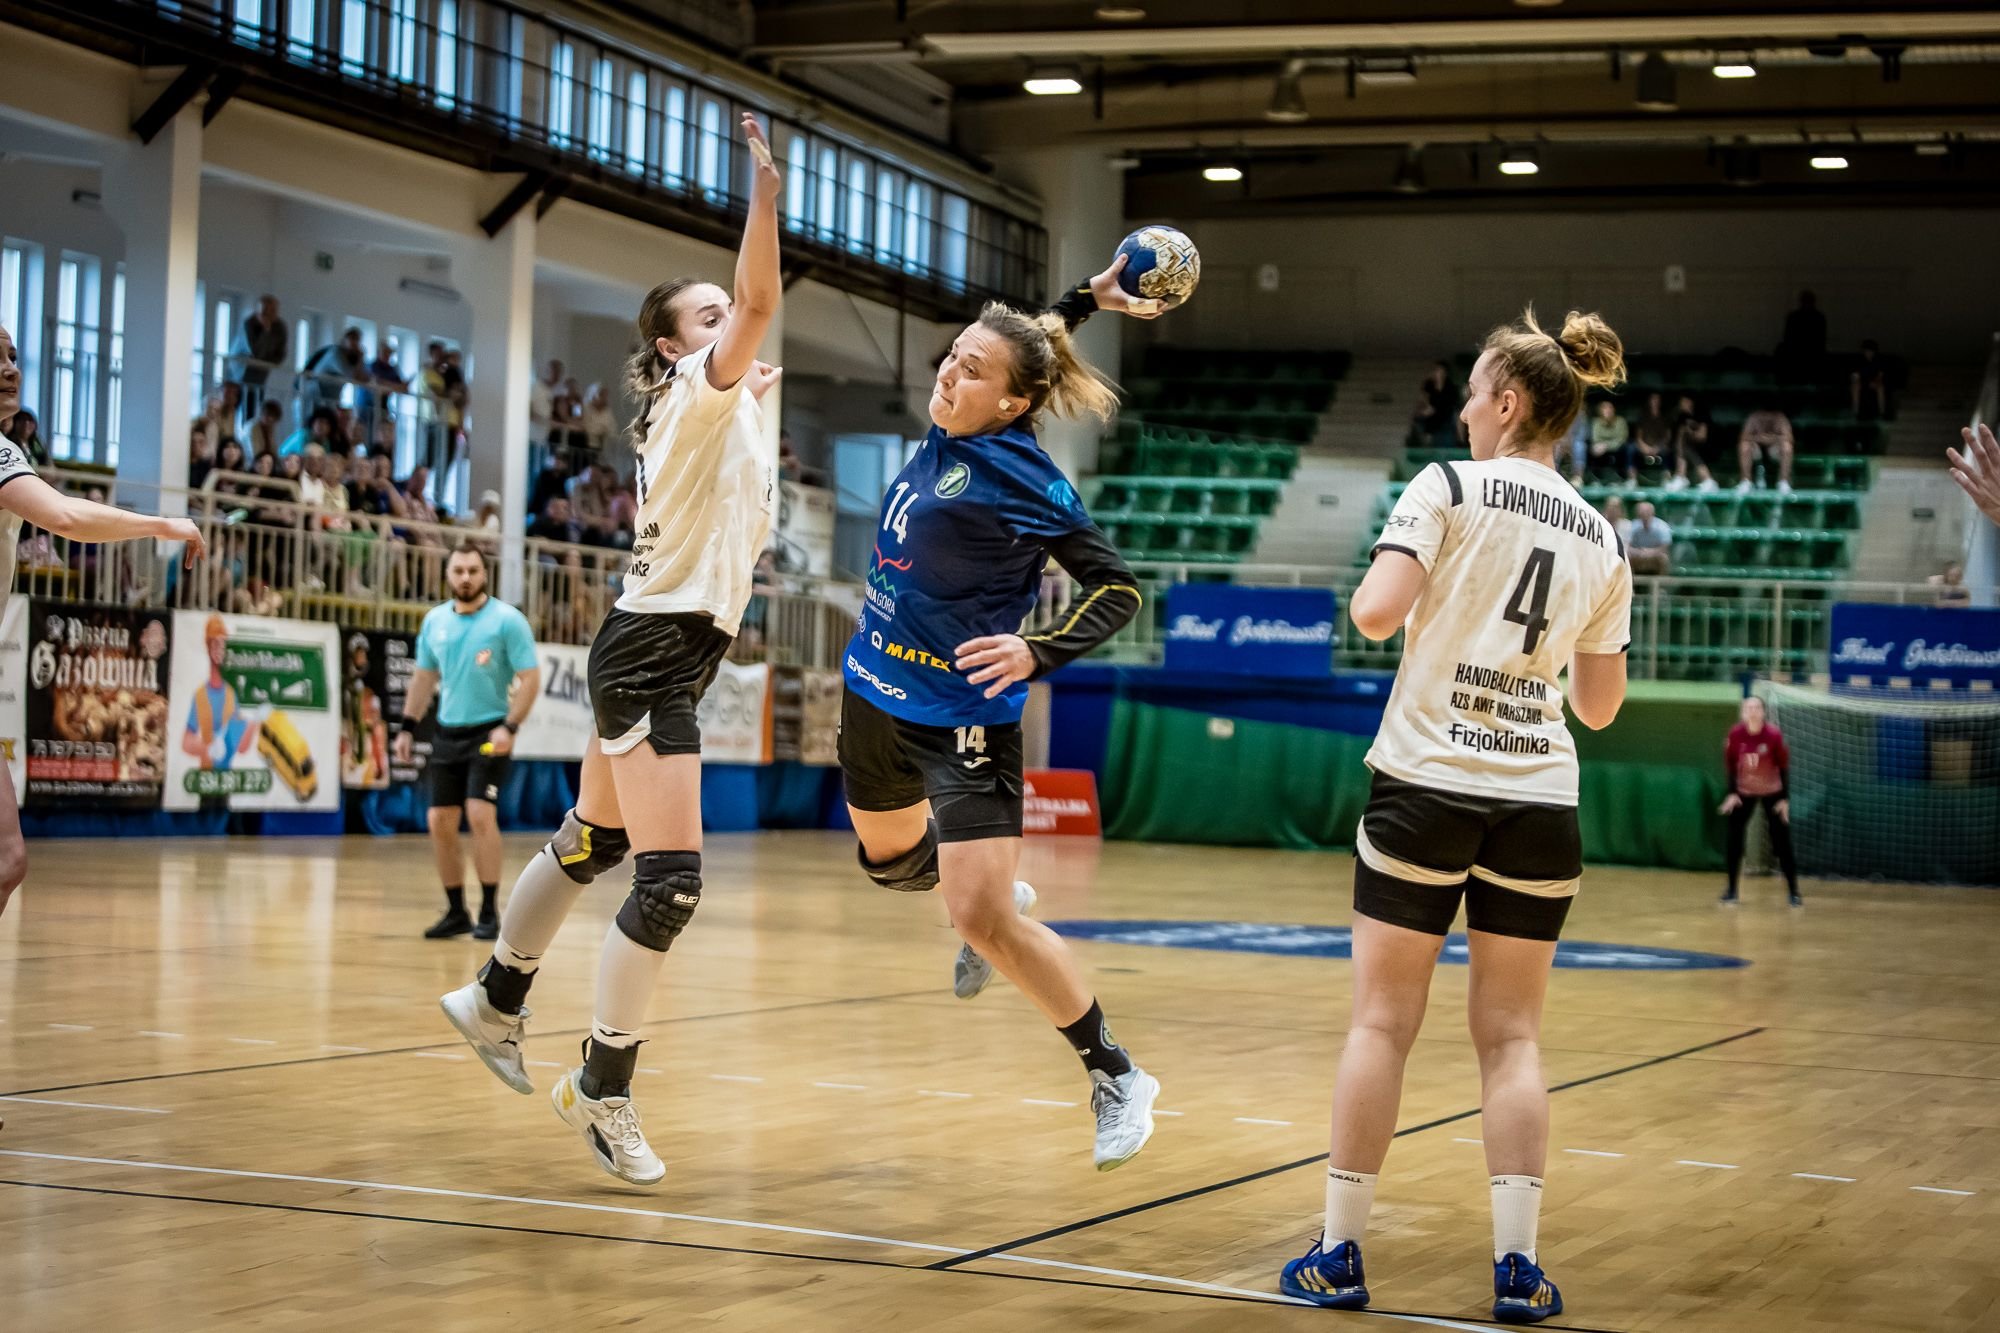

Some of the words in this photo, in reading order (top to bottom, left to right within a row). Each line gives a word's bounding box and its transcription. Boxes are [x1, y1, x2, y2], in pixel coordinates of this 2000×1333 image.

[883, 481, 919, 545] 14
[1483, 478, 1604, 548] LEWANDOWSKA
[1503, 547, 1556, 656] 4
[30, 640, 158, 690] Gazownia
[1450, 691, 1471, 710] AZS
[1472, 696, 1495, 715] AWF
[953, 725, 987, 753] 14
[1448, 722, 1550, 754] Fizjoklinika
